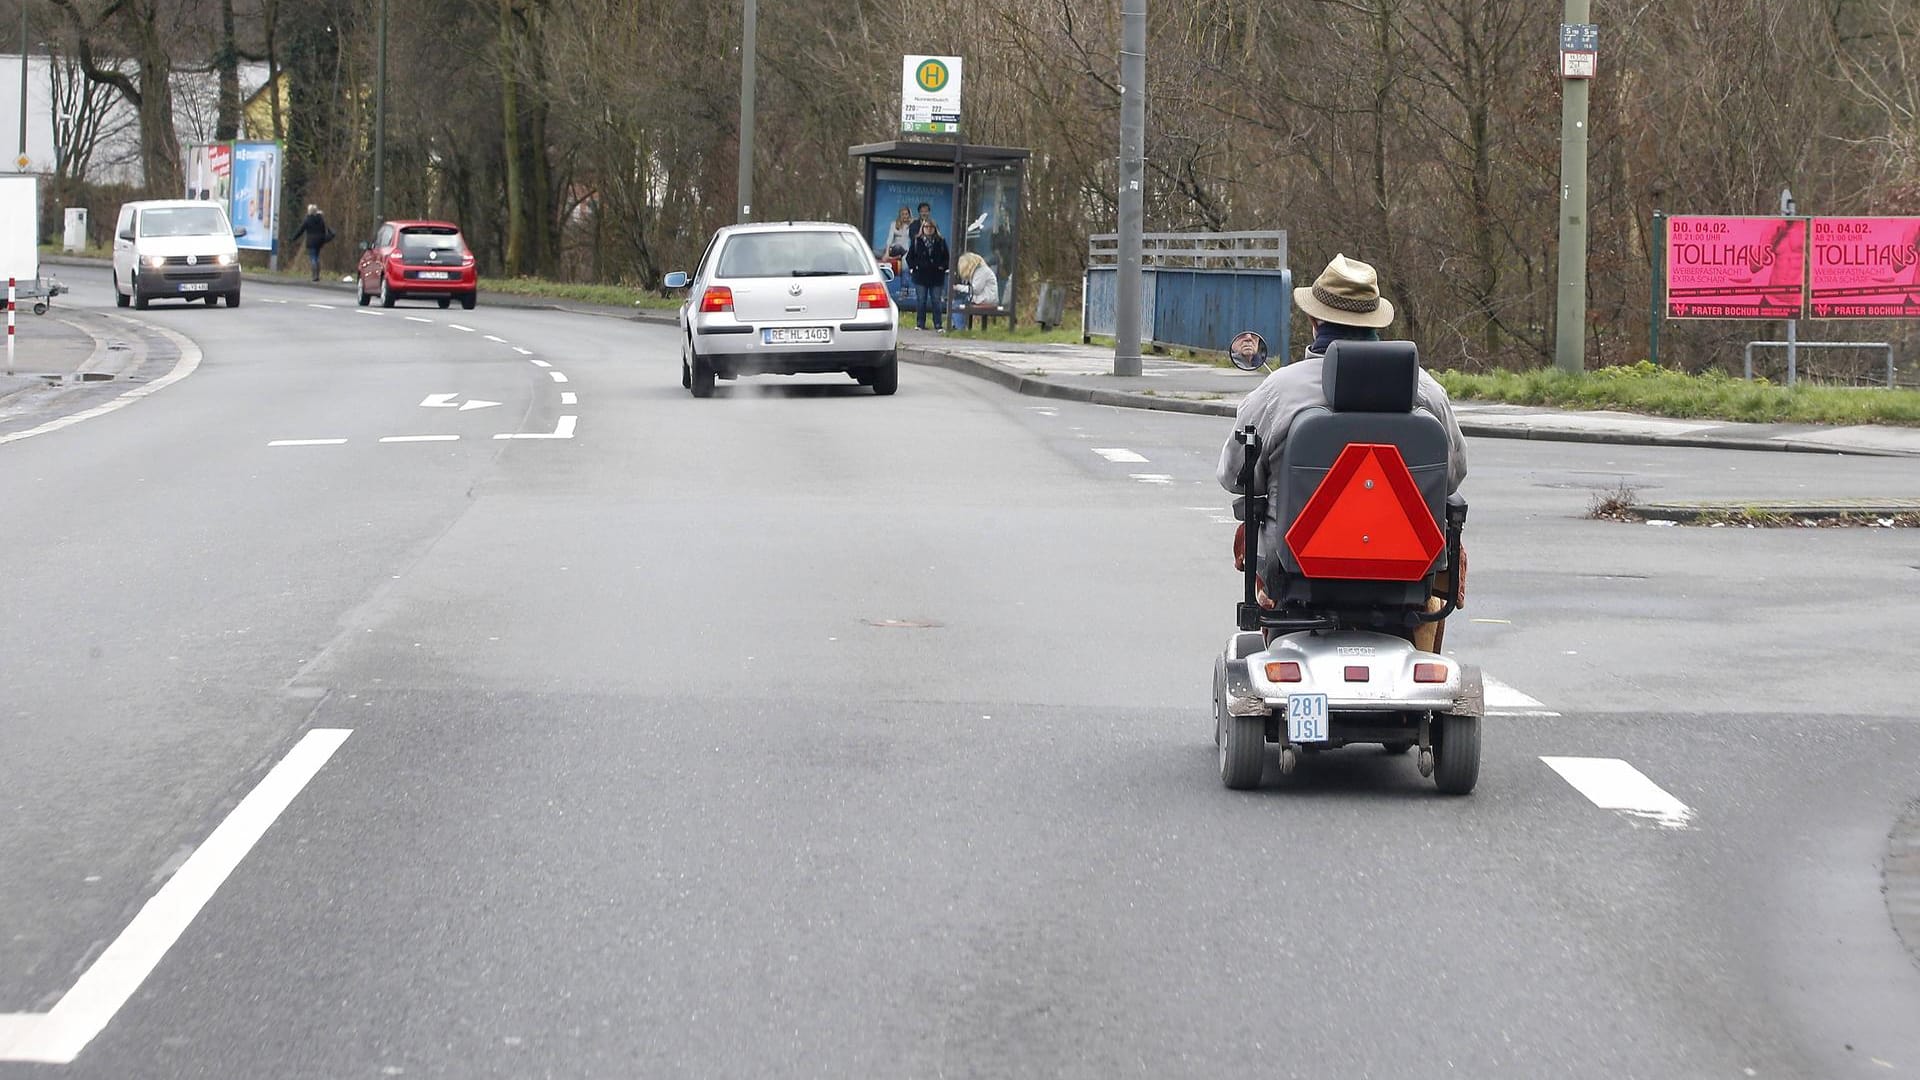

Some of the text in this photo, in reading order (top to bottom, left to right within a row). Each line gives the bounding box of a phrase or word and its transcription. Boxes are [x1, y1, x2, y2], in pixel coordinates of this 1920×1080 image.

[925, 66, 939, 85] H
[1673, 222, 1730, 234] DO. 04.02.
[1815, 223, 1872, 234] DO. 04.02.
[1673, 243, 1774, 266] TOLLHAUS
[1815, 244, 1917, 266] TOLLHAUS
[1691, 306, 1723, 316] PRATER
[1725, 306, 1759, 316] BOCHUM
[1834, 306, 1866, 316] PRATER
[1868, 306, 1903, 316] BOCHUM
[772, 329, 828, 340] RE HL 1403
[1291, 697, 1322, 717] 281
[1294, 719, 1323, 739] JSL
